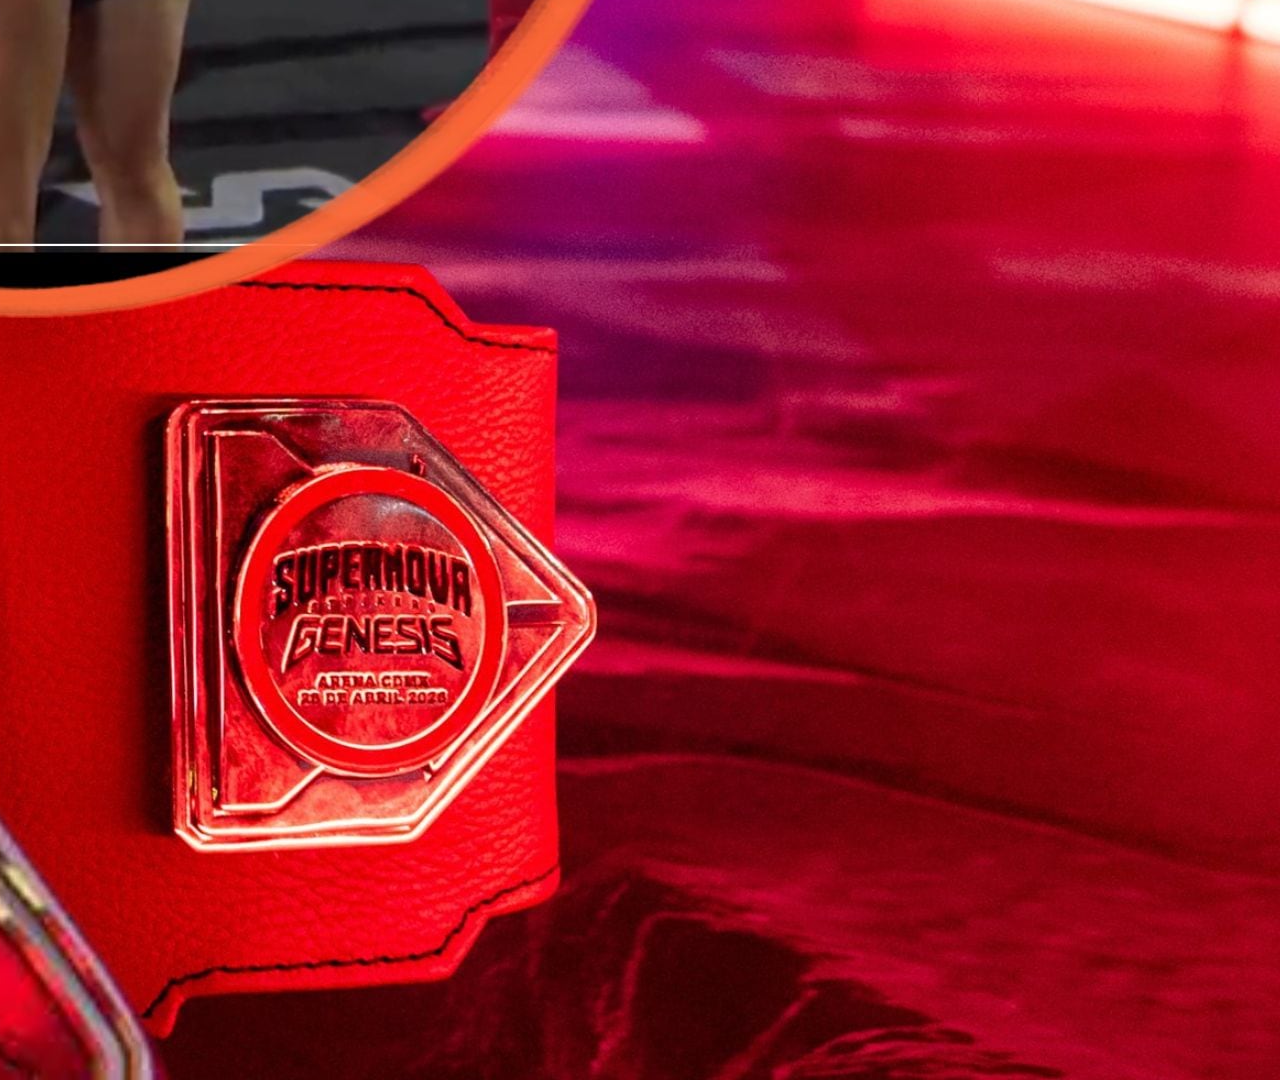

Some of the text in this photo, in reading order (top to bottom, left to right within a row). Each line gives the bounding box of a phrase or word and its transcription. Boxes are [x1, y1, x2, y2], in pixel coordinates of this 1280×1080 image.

[271, 541, 473, 618] SUPERNOVA
[281, 614, 464, 673] GENESIS
[315, 672, 377, 689] ARENA
[322, 689, 347, 706] DE
[349, 689, 405, 706] ABRIL
